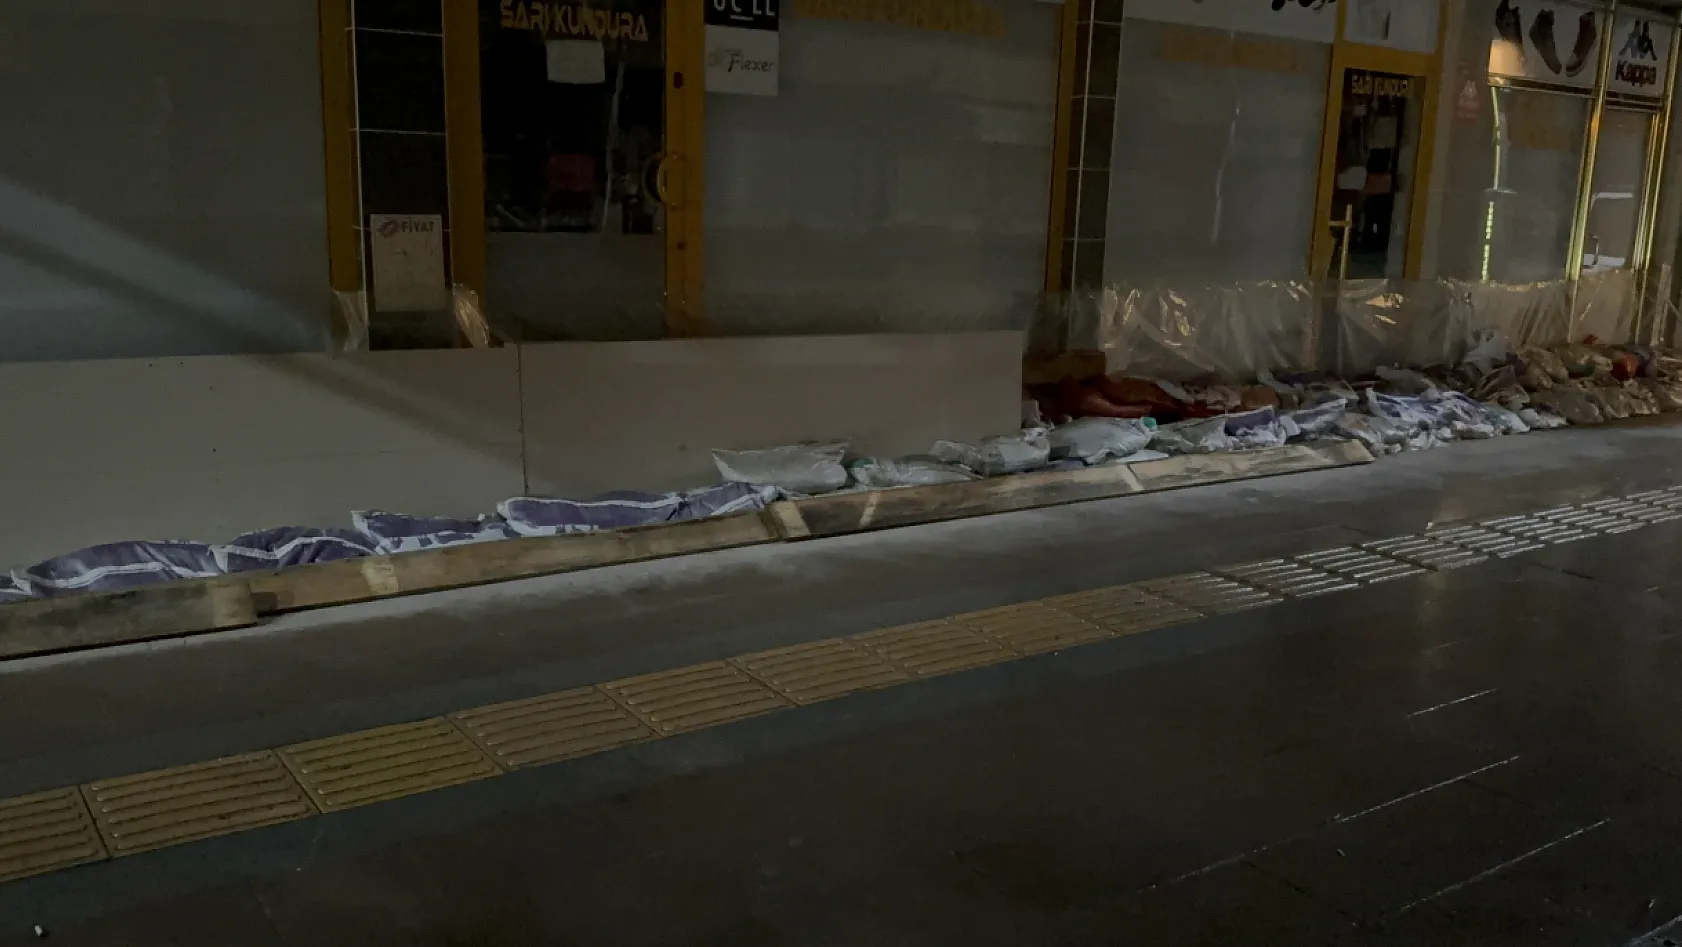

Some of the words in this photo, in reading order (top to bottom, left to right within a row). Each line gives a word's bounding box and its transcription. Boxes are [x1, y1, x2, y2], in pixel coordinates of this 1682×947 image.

[499, 0, 549, 30] SARI
[553, 3, 648, 41] KUNDURA
[1615, 60, 1656, 87] Kappa
